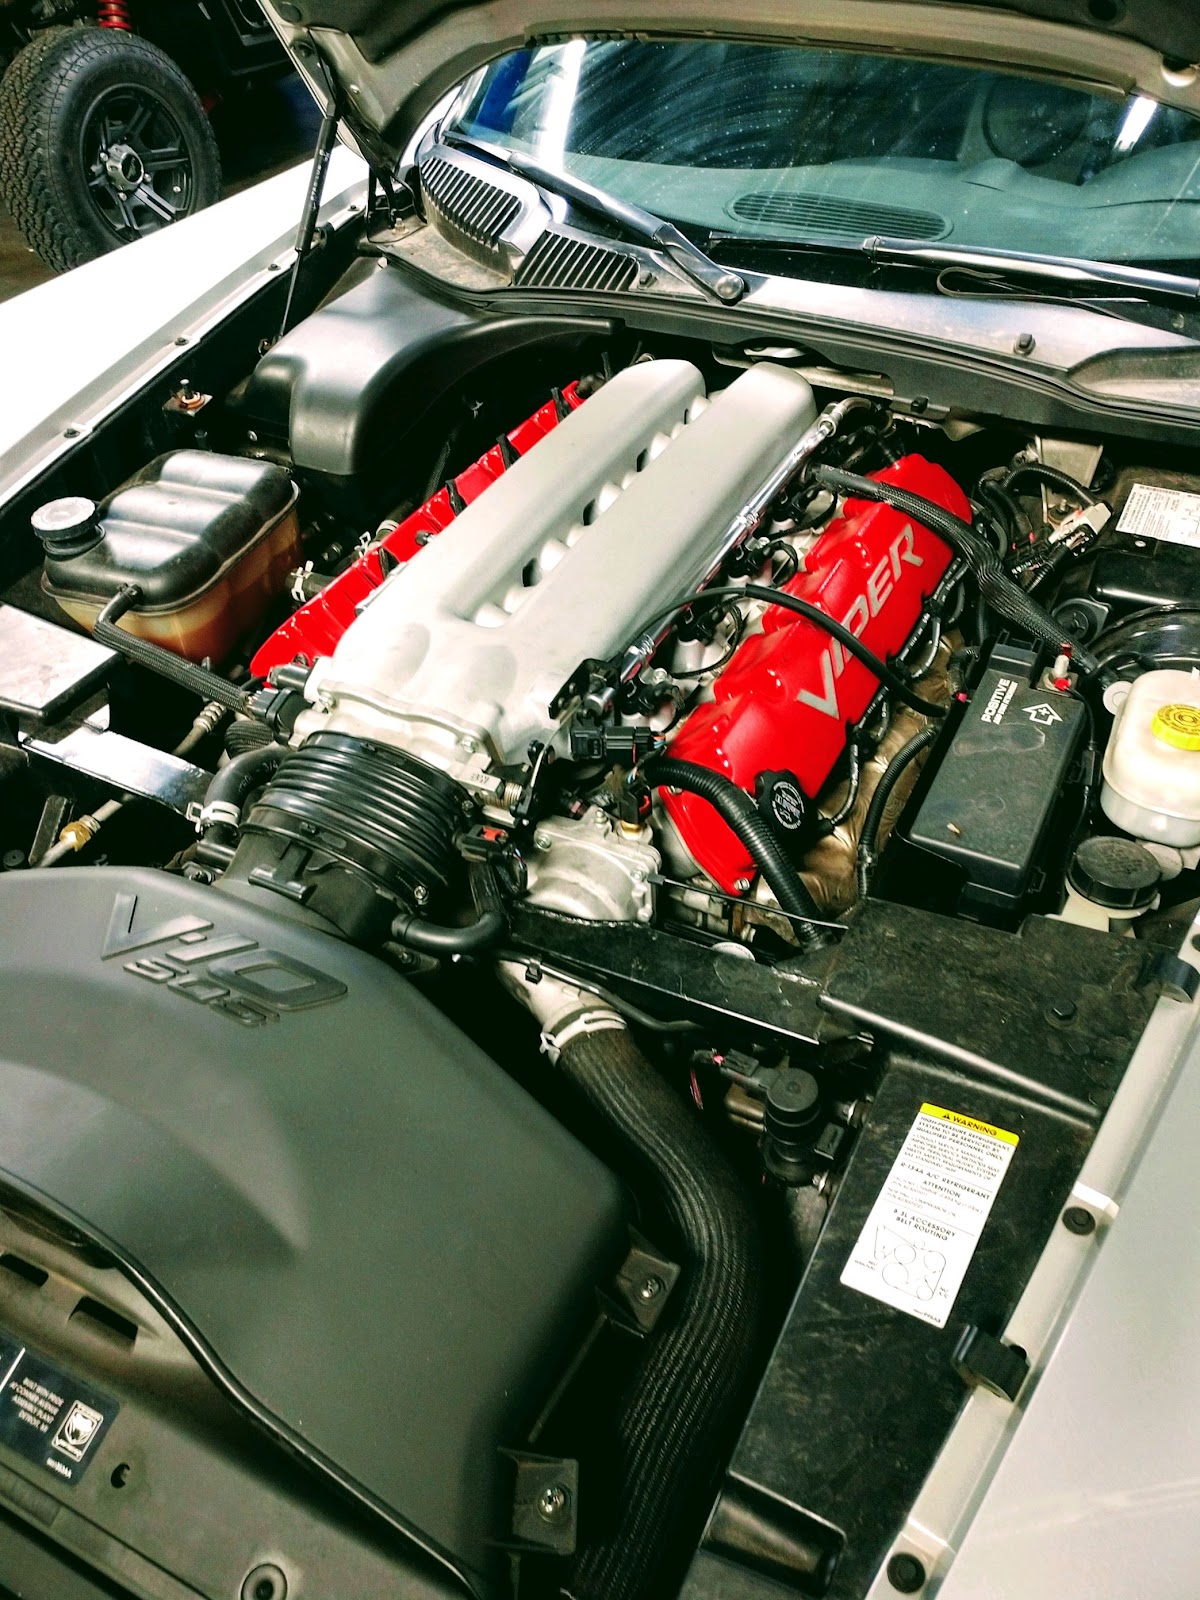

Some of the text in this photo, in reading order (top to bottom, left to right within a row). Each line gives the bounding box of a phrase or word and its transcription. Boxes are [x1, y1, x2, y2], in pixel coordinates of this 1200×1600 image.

[796, 523, 924, 720] VIPER
[981, 678, 1010, 723] POSITIVE
[919, 1121, 940, 1131] SYSTEM
[960, 1136, 990, 1149] SERVICED
[953, 1116, 997, 1135] WARNING
[916, 1126, 946, 1139] QUALIFIED
[948, 1138, 983, 1153] PERSONNEL
[968, 1133, 1009, 1150] REFRIGERANT
[900, 1162, 989, 1199] R-134A A/C REFRIGERANT
[922, 1179, 960, 1197] ATTENTION
[896, 1216, 947, 1240] BELT ROUTING
[910, 1215, 954, 1236] ACCESSORY
